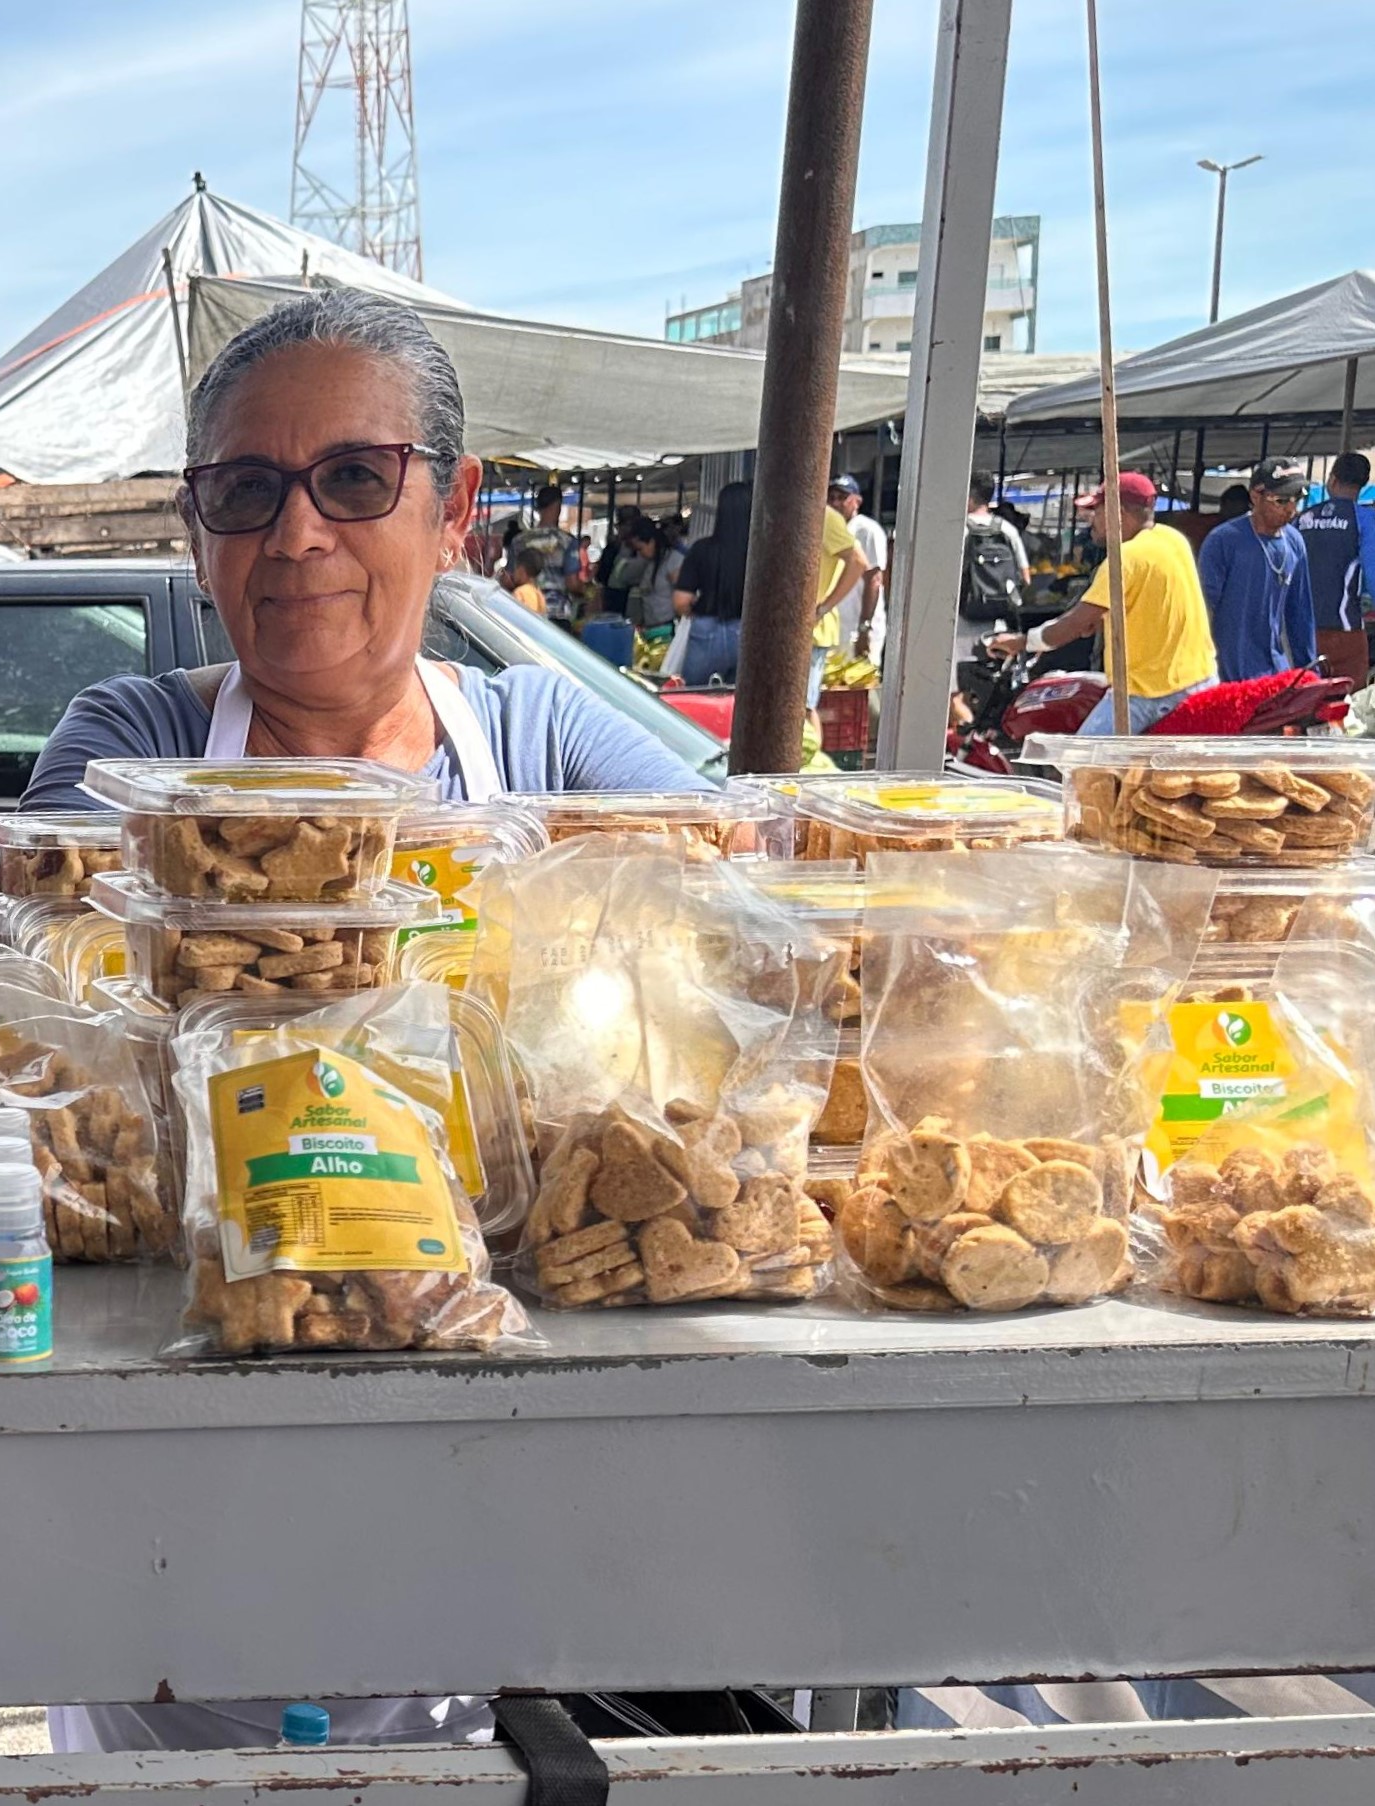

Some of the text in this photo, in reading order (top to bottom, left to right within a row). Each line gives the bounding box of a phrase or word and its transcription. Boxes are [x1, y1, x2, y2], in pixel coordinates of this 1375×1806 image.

[1212, 1052, 1259, 1064] Sabor
[1200, 1061, 1275, 1074] Artesanal
[1211, 1082, 1275, 1095] Biscoito
[305, 1104, 352, 1118] Sabor
[289, 1115, 368, 1130] Artesanal
[301, 1136, 366, 1152] Biscoito
[310, 1156, 364, 1176] Alho
[22, 1312, 38, 1323] de
